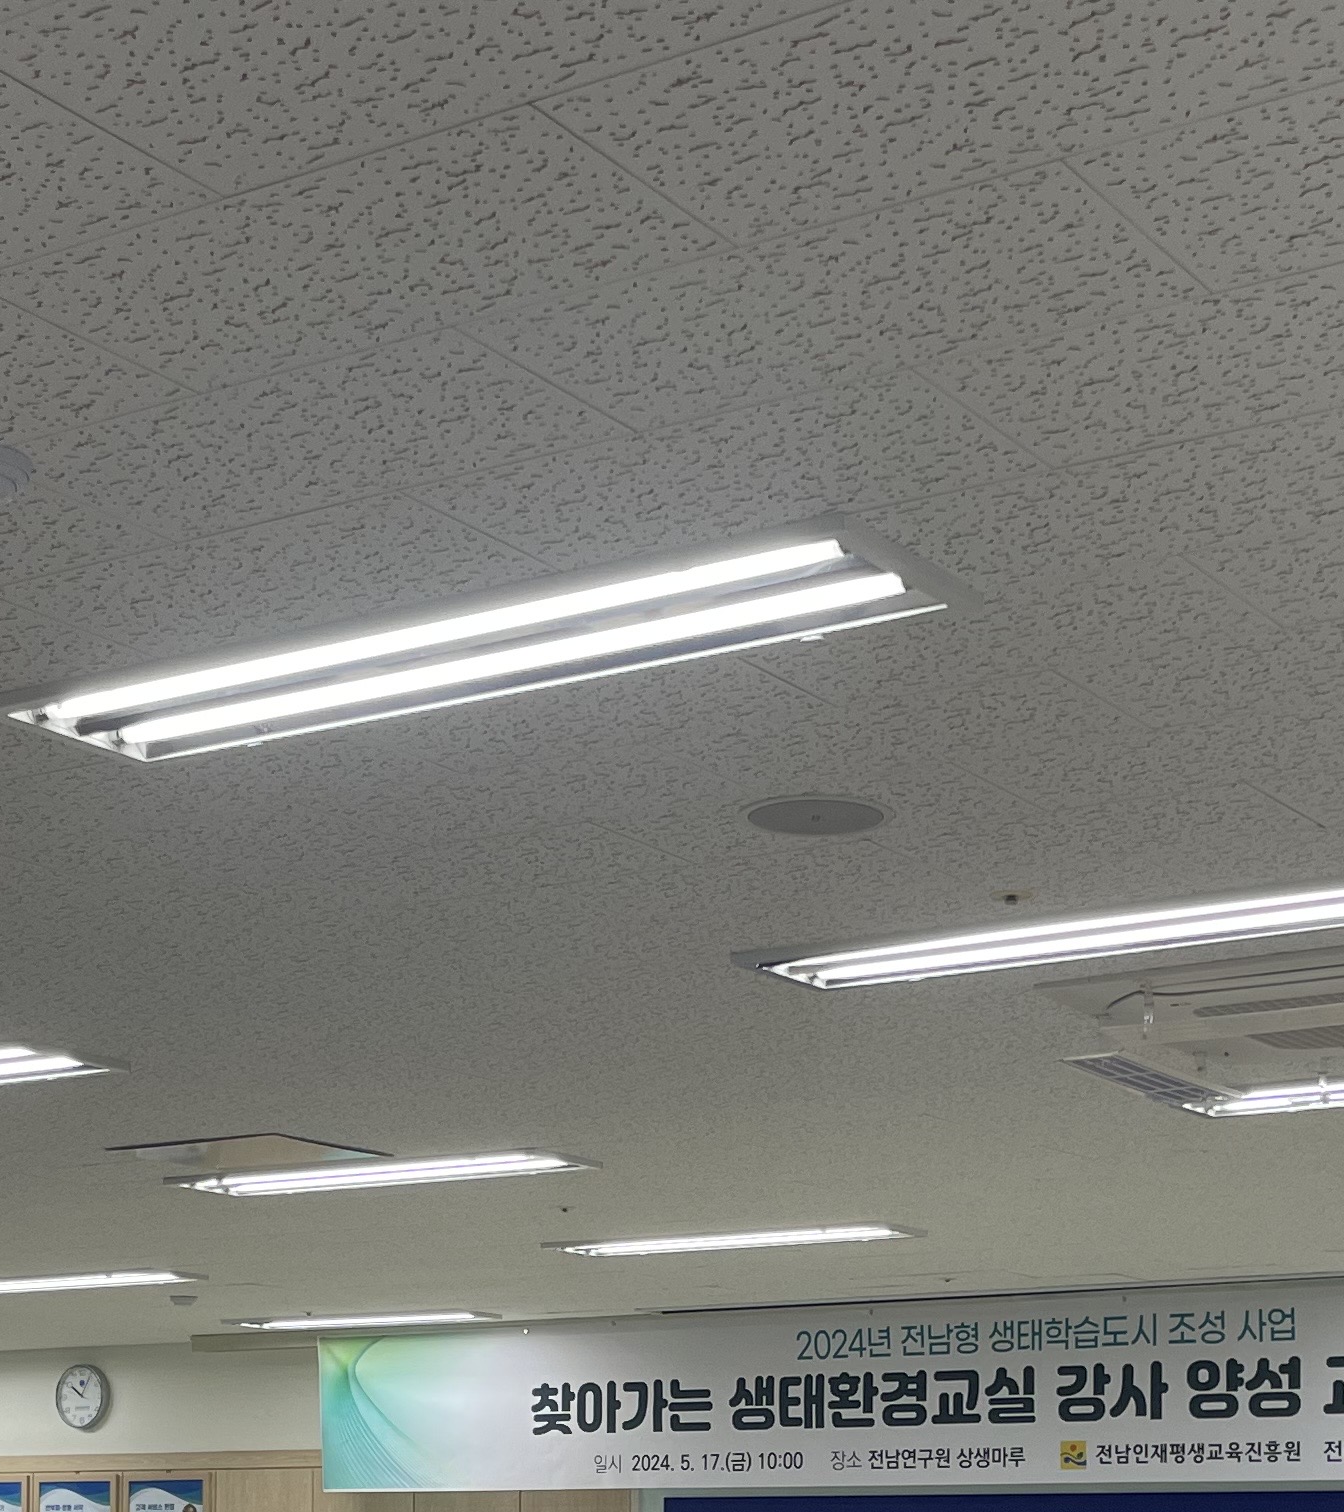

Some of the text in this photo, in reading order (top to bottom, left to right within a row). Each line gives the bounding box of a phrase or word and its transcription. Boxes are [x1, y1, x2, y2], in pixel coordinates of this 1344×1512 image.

[796, 1306, 1297, 1361] 2024년 전남형 생태학습도시 조성 사업
[530, 1378, 714, 1436] 찾아가는
[728, 1365, 1037, 1433] 생태환경교실
[1055, 1360, 1169, 1423] 강사
[1185, 1355, 1303, 1420] 양성
[593, 1446, 1026, 1474] 일시 2024. 5. 17.(금) 10:00 장소 전남연구원 상생마루
[1094, 1440, 1302, 1465] 전남인재평생교육진흥원
